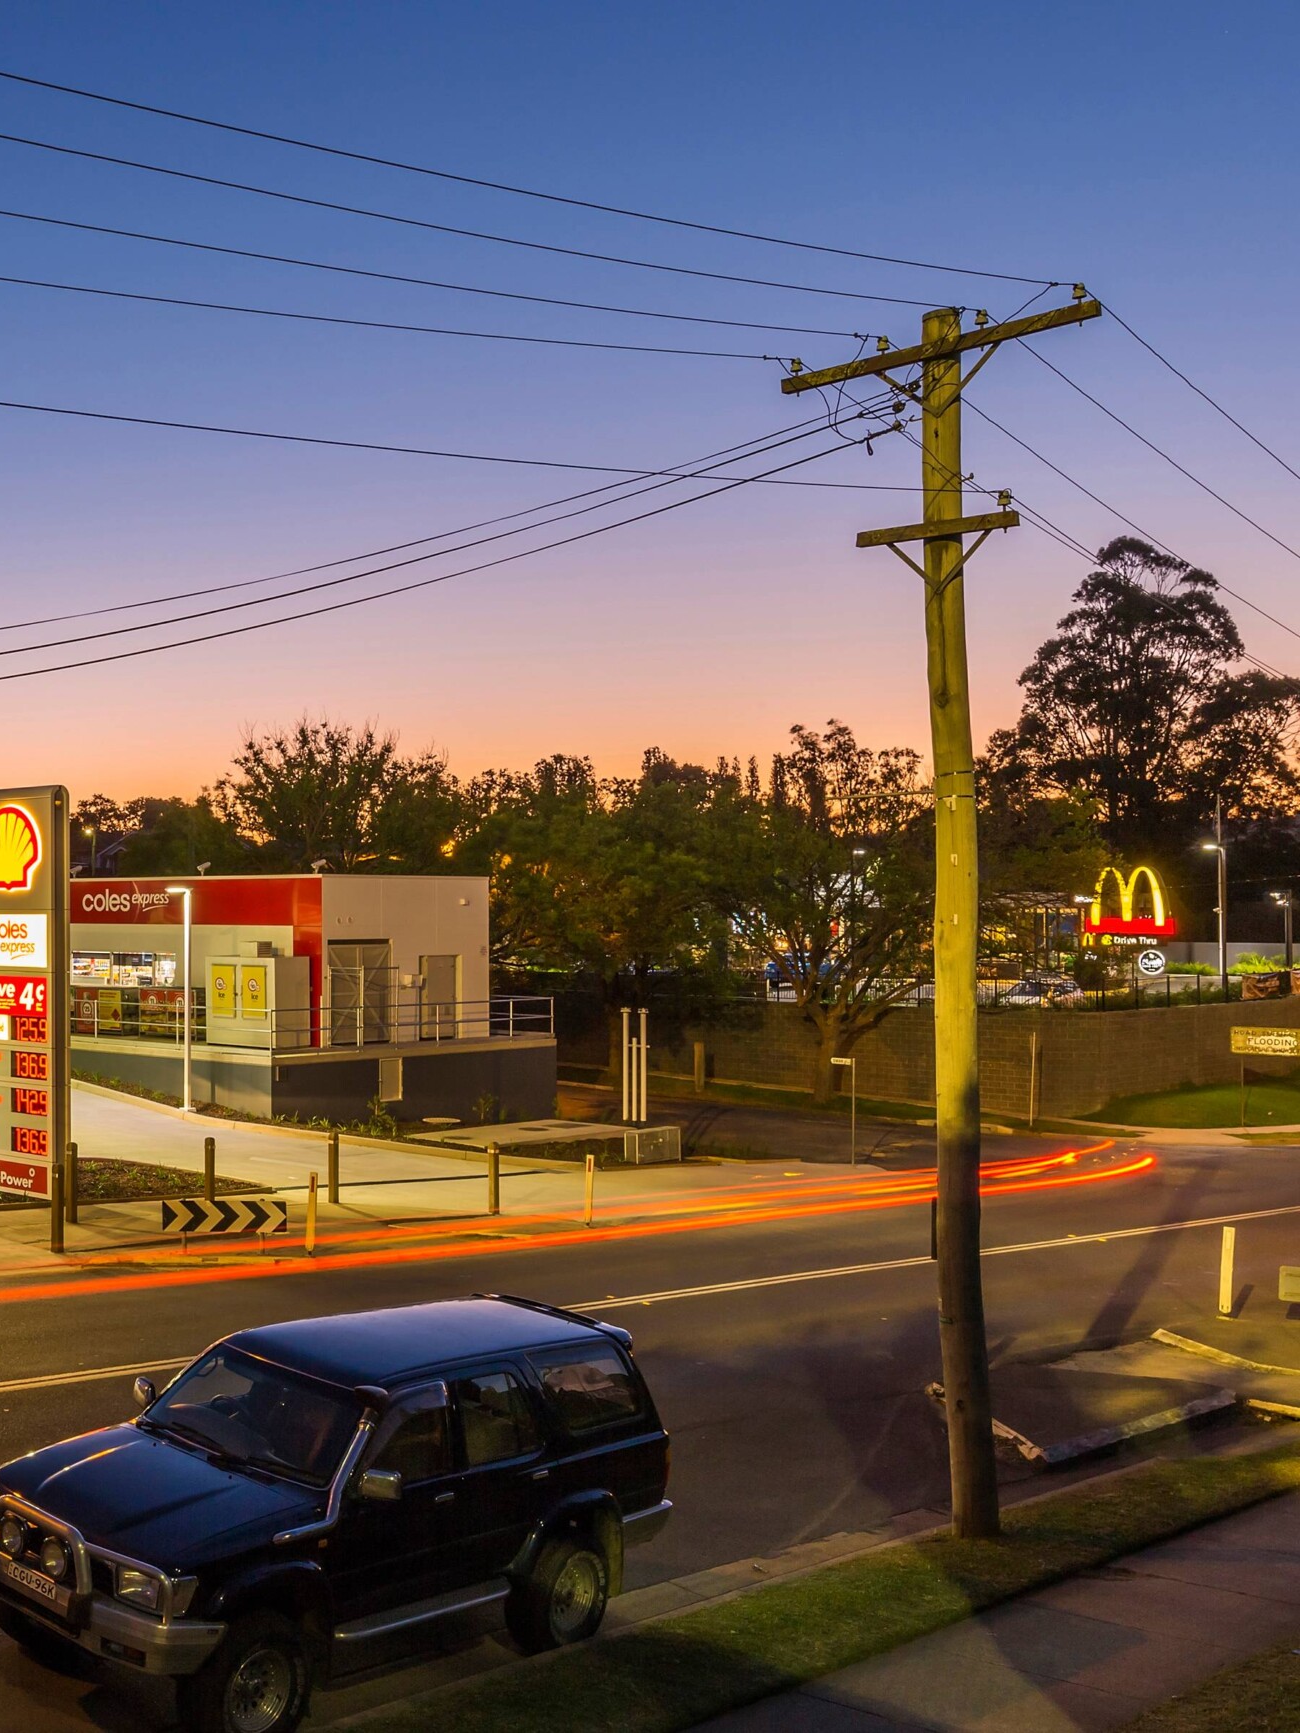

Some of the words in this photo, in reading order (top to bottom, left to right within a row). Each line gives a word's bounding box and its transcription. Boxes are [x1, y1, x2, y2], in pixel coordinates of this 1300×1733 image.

[82, 888, 131, 912] coles
[131, 893, 170, 908] express
[0, 942, 35, 956] express
[16, 1017, 48, 1043] 125.9
[16, 1052, 48, 1079] 136.9
[15, 1088, 48, 1116] 142.9
[15, 1127, 48, 1156] 136.9
